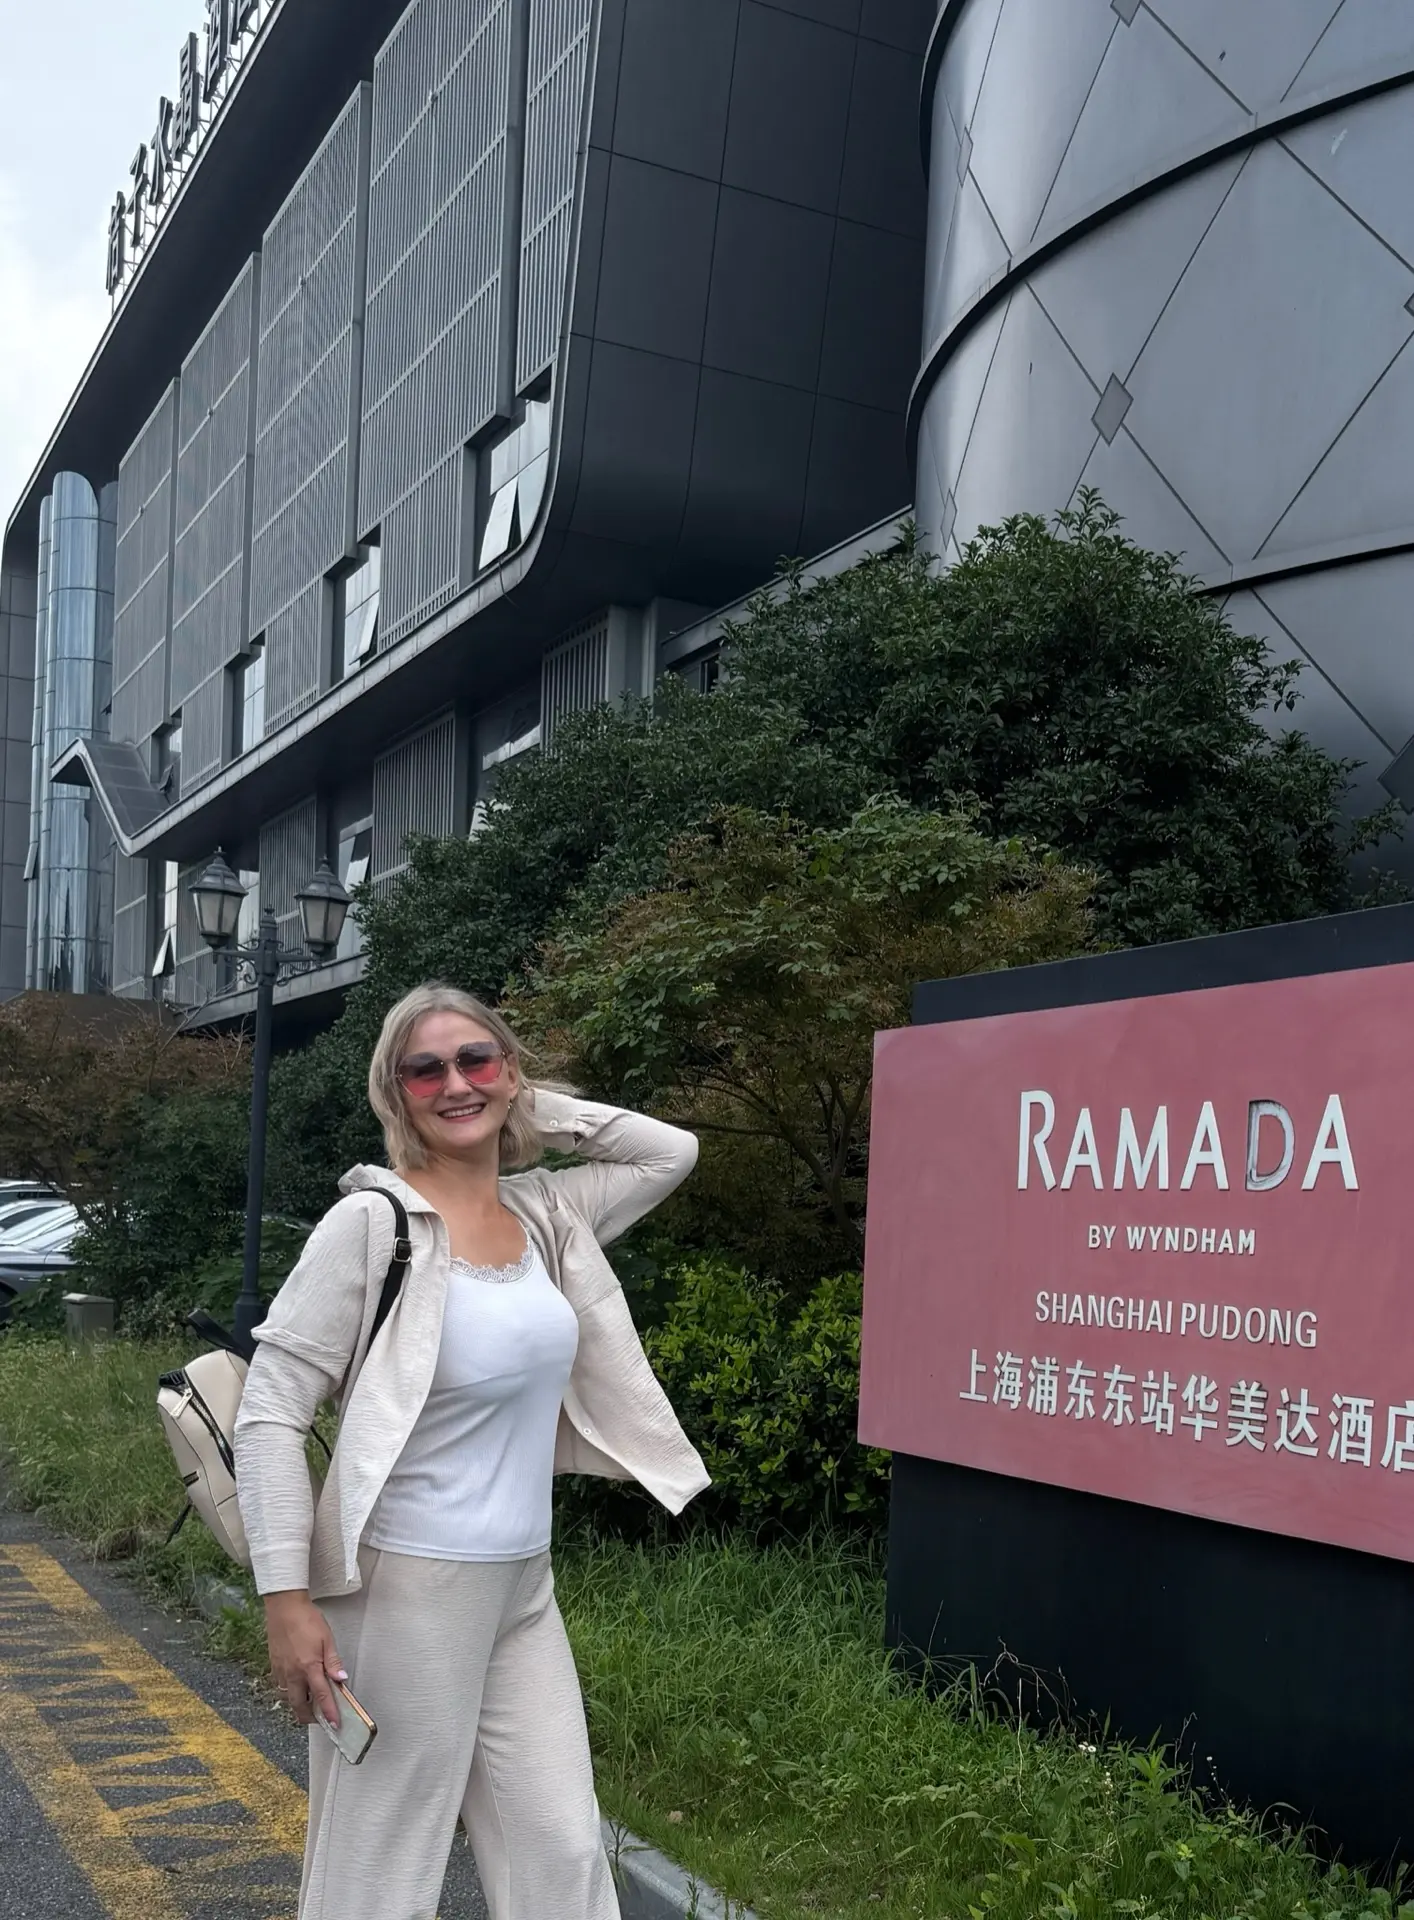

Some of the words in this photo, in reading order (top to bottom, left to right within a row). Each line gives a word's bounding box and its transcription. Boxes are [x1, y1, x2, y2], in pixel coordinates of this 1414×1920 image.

[1018, 1090, 1358, 1190] RAMADA
[1089, 1225, 1116, 1248] BY
[1127, 1226, 1255, 1254] WYNDHAM
[1036, 1291, 1172, 1333] SHANGHAI
[1181, 1303, 1316, 1347] PUDONG
